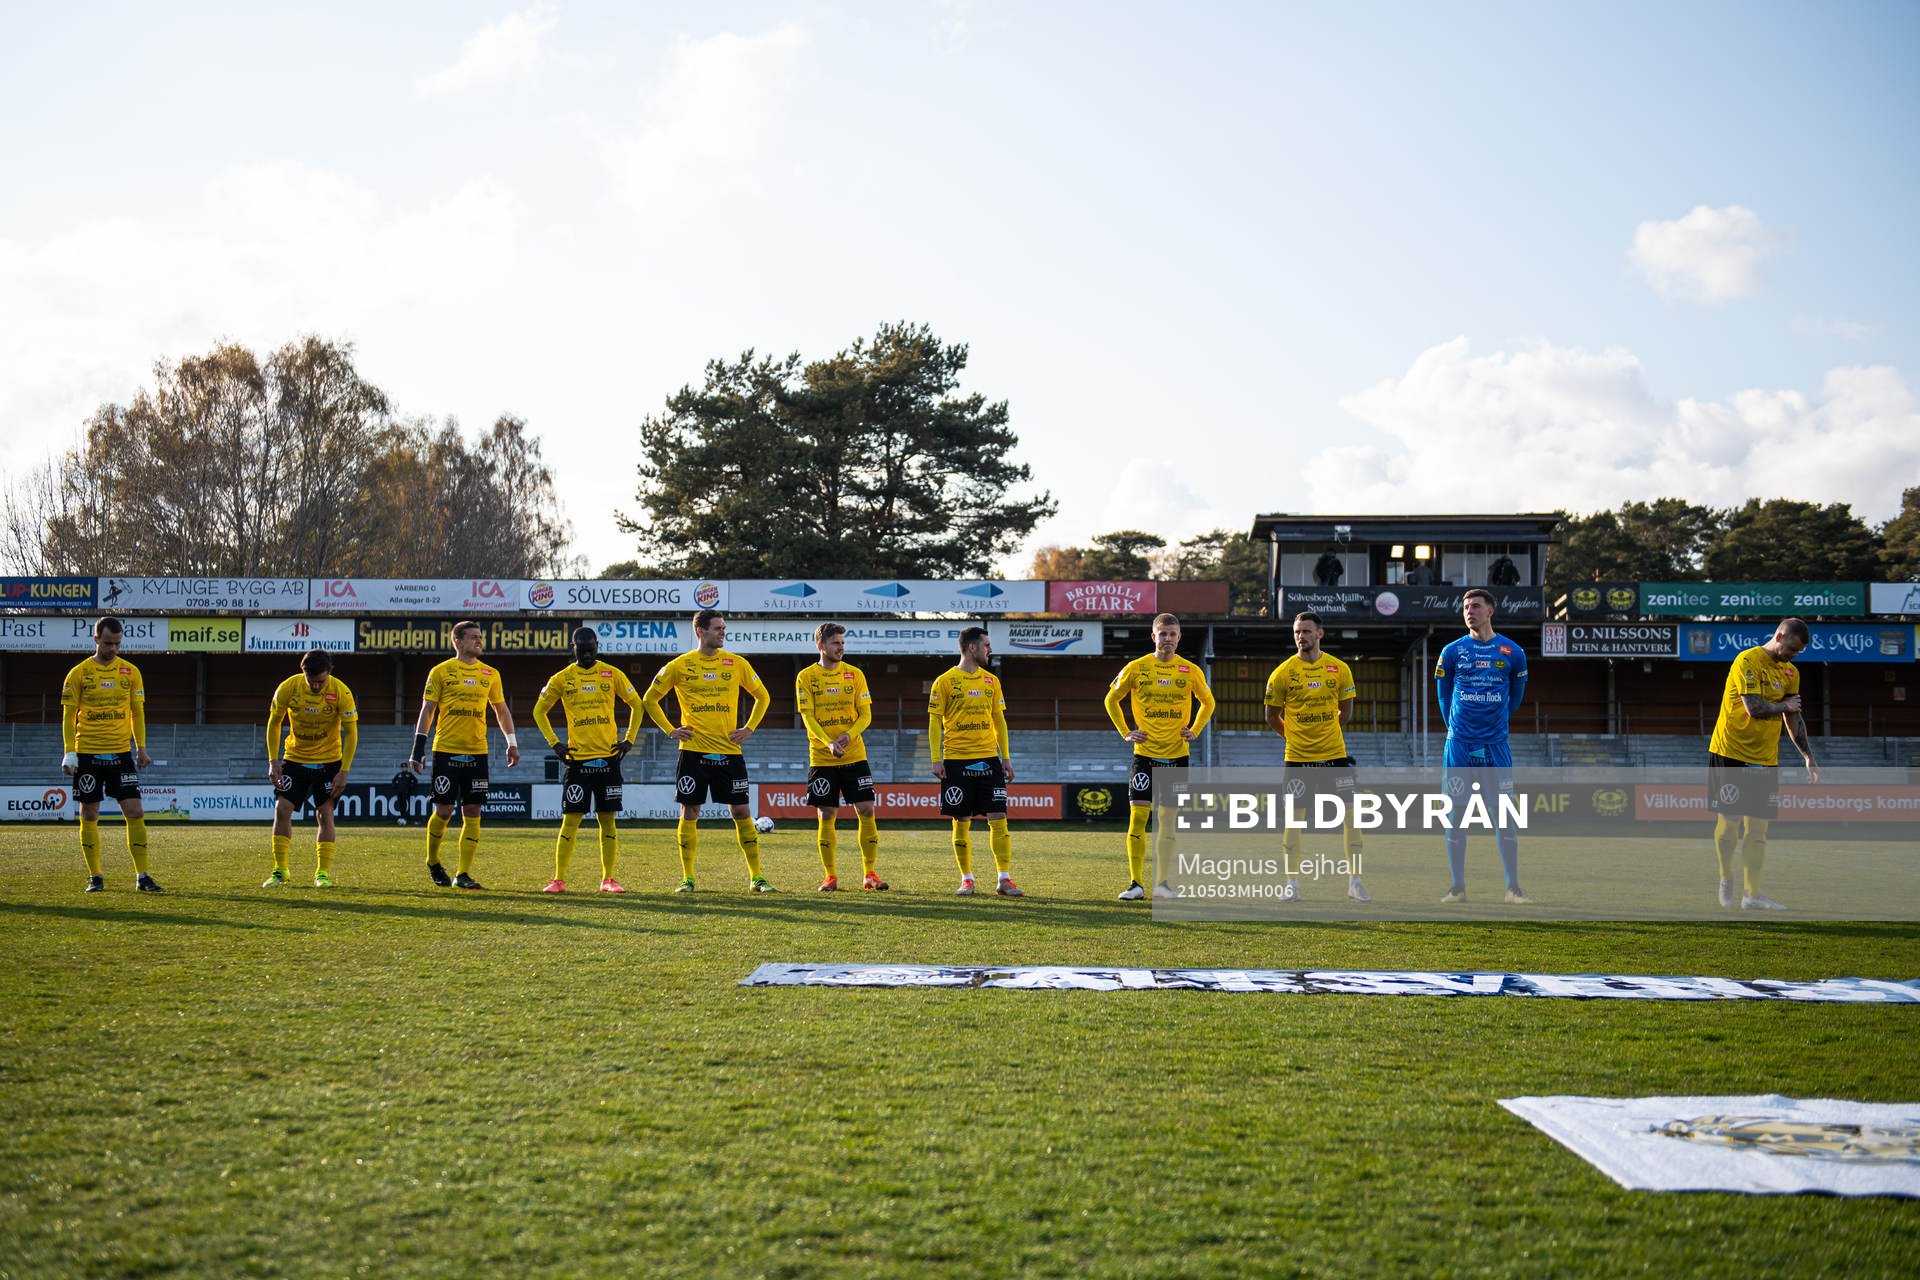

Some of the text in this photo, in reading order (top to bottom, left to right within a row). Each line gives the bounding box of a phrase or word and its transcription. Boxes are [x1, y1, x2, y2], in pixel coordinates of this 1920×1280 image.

[142, 579, 304, 596] KYLINGE BYGG AB
[324, 581, 357, 598] ICA
[472, 581, 504, 598] ICA
[531, 586, 553, 598] BURGER
[696, 586, 718, 597] BURGER
[1065, 583, 1142, 602] BROMÖLLA
[531, 592, 554, 603] KING
[567, 585, 681, 604] SÖLVESBORG
[697, 592, 719, 603] KING
[1648, 590, 1710, 606] zenitec
[1720, 590, 1783, 606] zenitec
[1793, 590, 1857, 606] zenitec
[186, 599, 260, 608] 0708-90 88 16
[314, 599, 368, 609] Supermarket
[404, 597, 424, 605] dagar
[462, 600, 515, 609] Supermarket
[1072, 597, 1135, 611] CHARK
[1423, 595, 1448, 608] Med
[1307, 603, 1347, 613] Sparbank
[169, 626, 240, 643] maif.se
[291, 622, 310, 637] JB
[358, 621, 436, 649] Sweden
[491, 621, 569, 650] Festival
[615, 621, 678, 639] STENA
[844, 630, 941, 639] AHLBERG
[1009, 629, 1040, 638] MASKIN
[1051, 629, 1070, 637] LACK
[1072, 629, 1084, 637] AB
[1571, 627, 1671, 640] O. NILSSONS
[725, 632, 815, 642] CENTERPARTI
[310, 640, 351, 650] BYGGER
[1571, 643, 1672, 653] STEN & HANTVERK
[1811, 634, 1825, 650] &
[1829, 633, 1874, 654] Miljö
[1460, 690, 1502, 702] Sweden Rock
[691, 703, 716, 713] Sweden
[1144, 707, 1169, 718] Sweden
[7, 800, 56, 811] ELCOM
[193, 795, 276, 809] SYDSTÄLLNIN
[1003, 796, 1054, 807] mmun
[1533, 793, 1570, 813] AIF
[1643, 793, 1708, 809] Välkom
[480, 804, 526, 813] RLSKRONA
